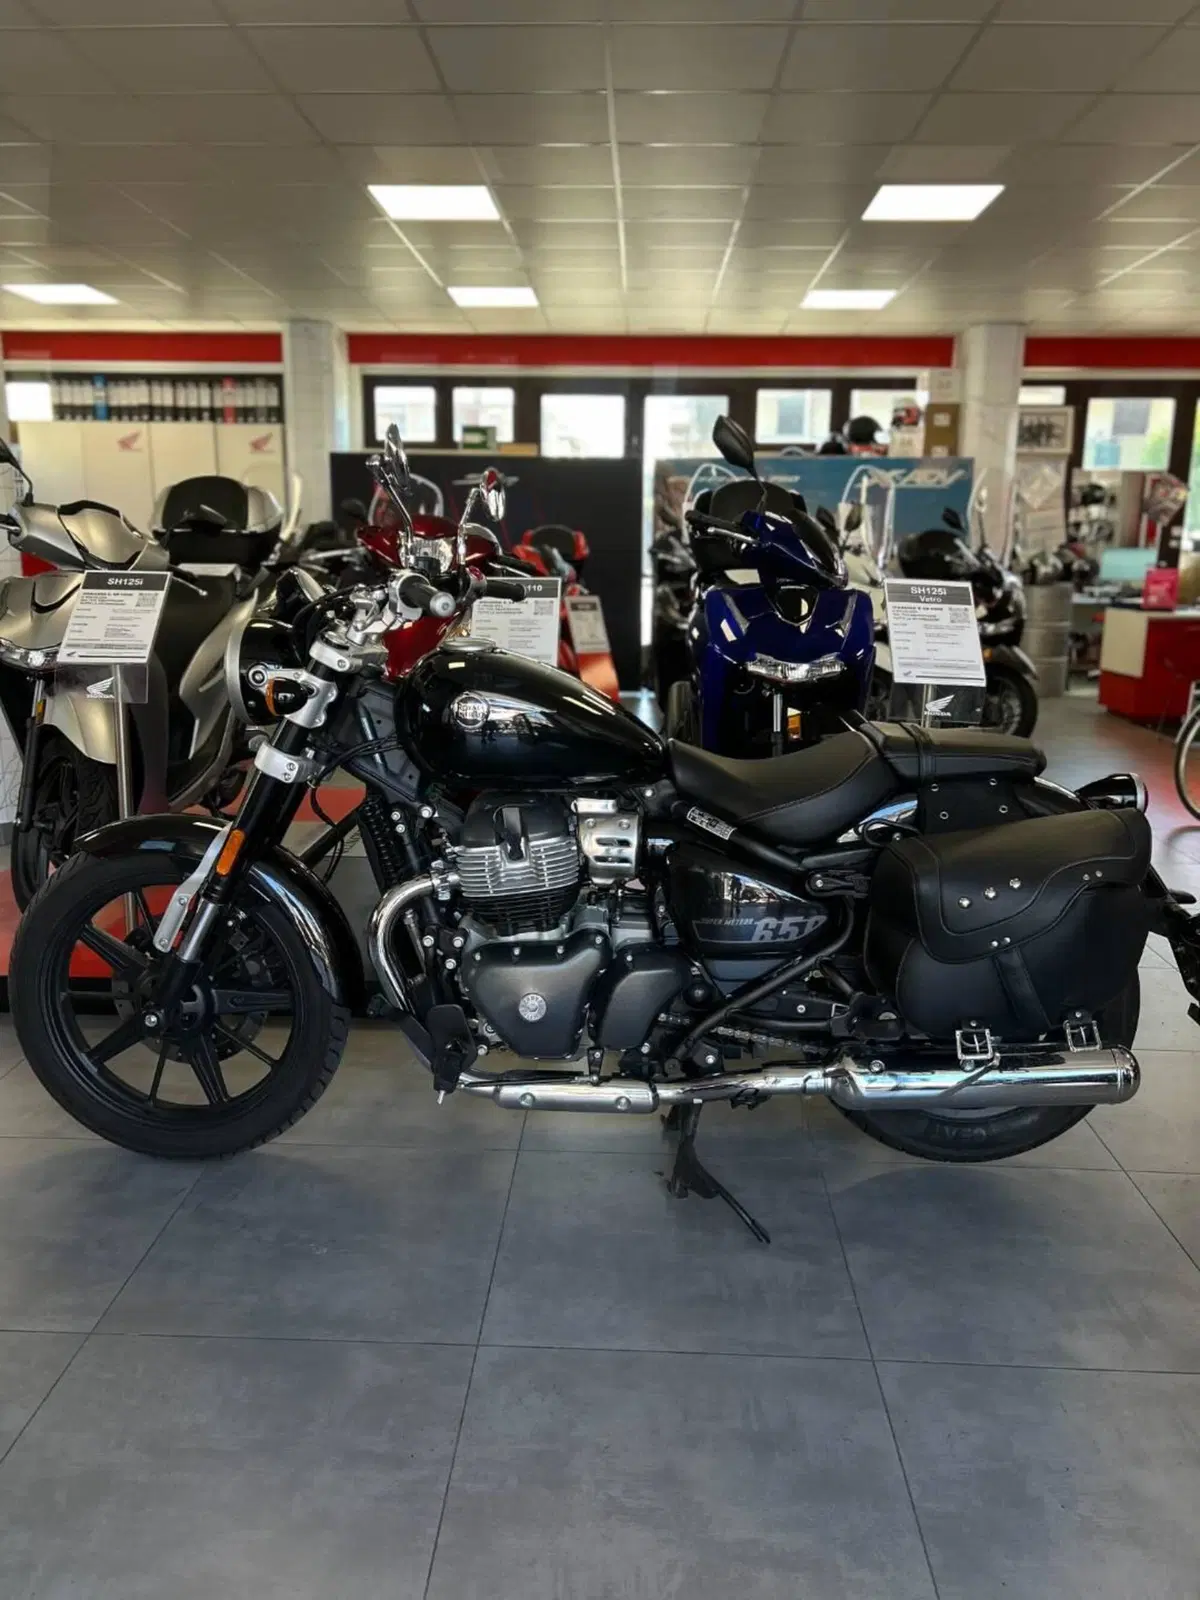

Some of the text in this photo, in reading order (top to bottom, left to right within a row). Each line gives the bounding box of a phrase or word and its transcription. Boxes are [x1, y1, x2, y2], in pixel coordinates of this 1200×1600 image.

[107, 577, 144, 586] SH125i
[526, 584, 543, 592] 110
[910, 586, 947, 596] SH125i
